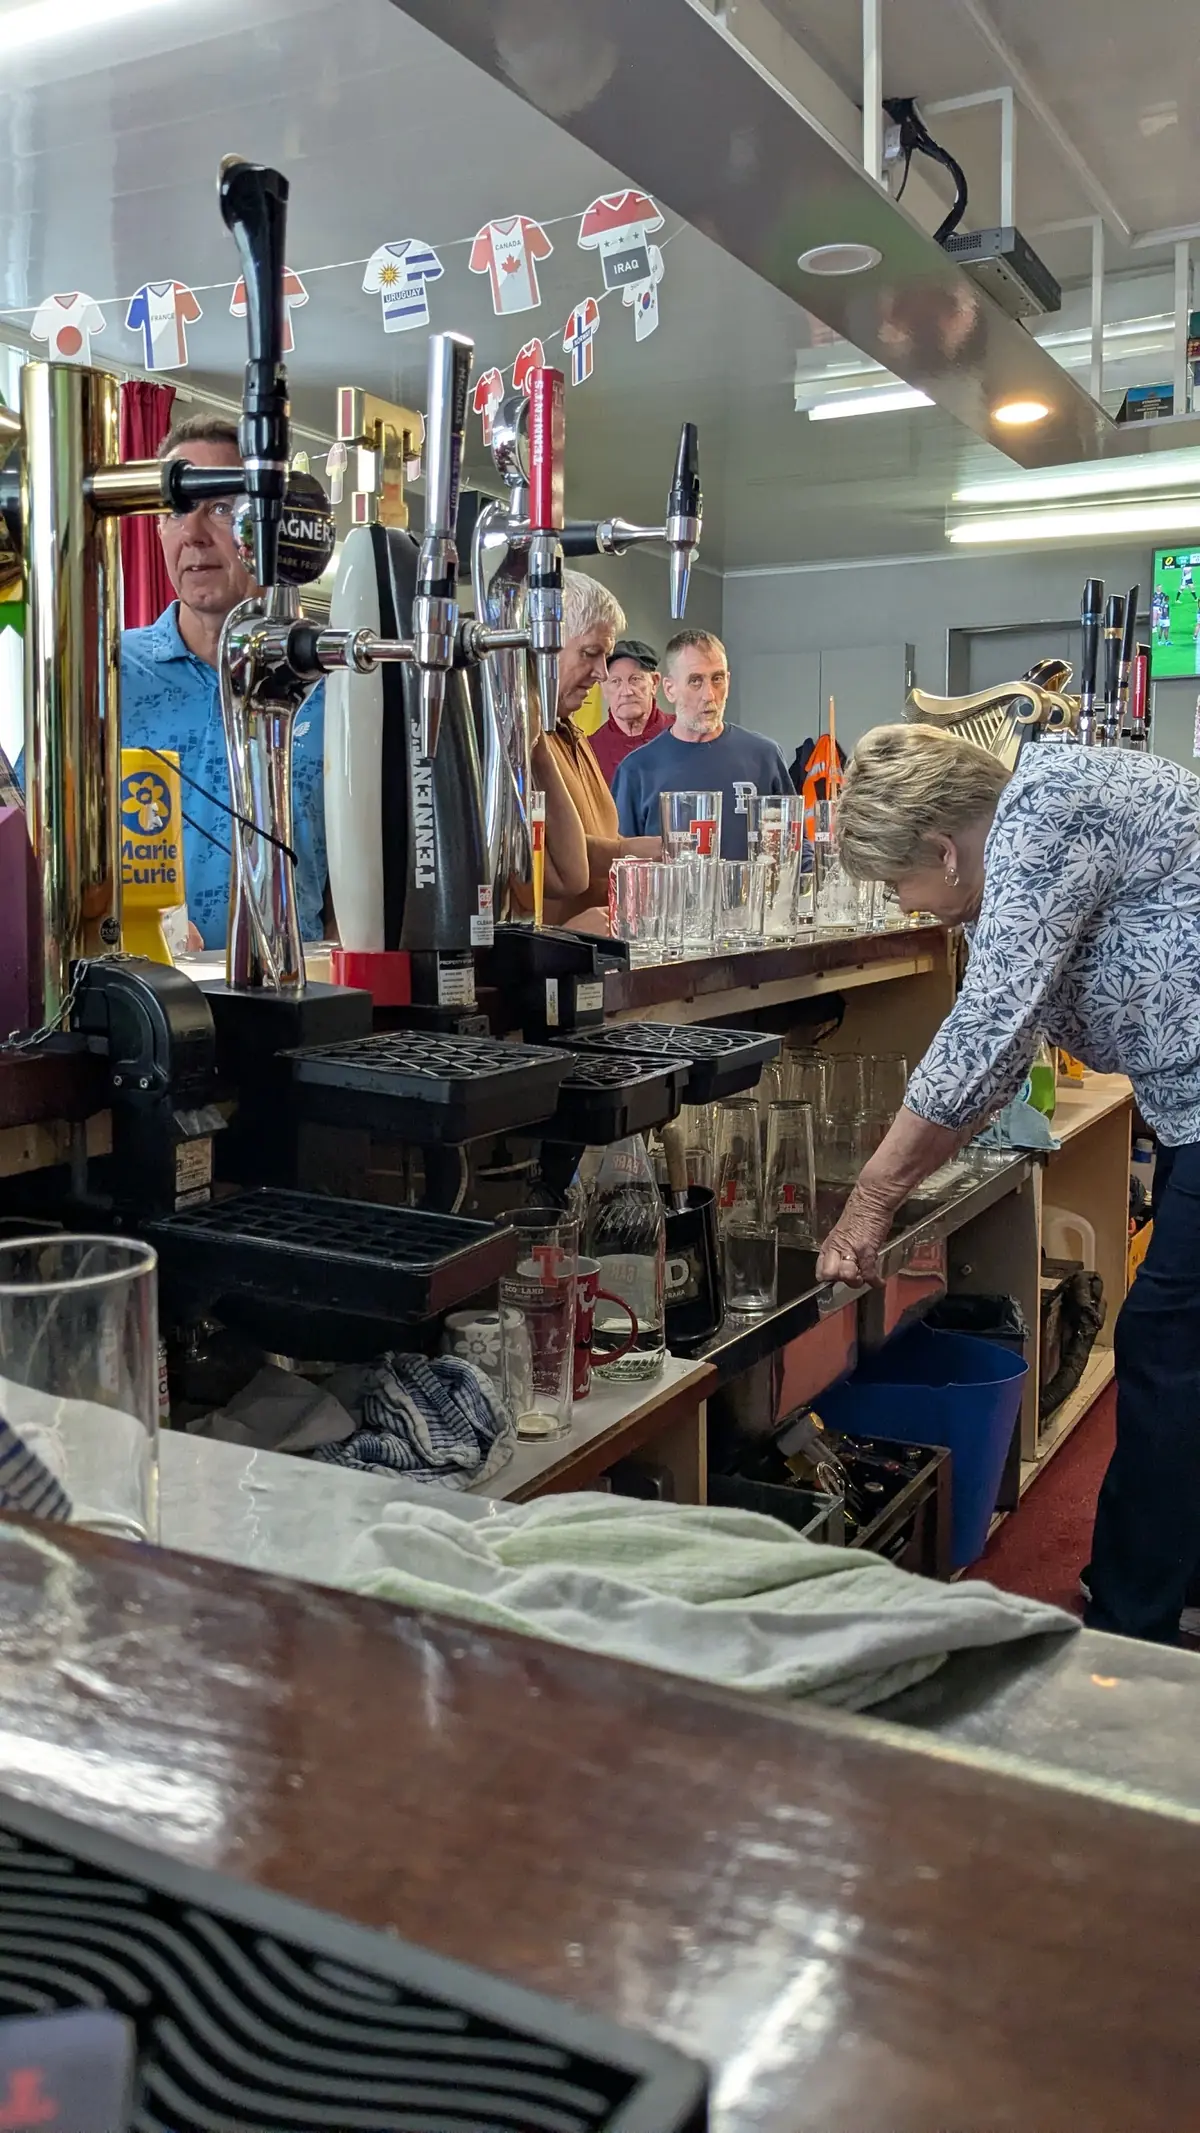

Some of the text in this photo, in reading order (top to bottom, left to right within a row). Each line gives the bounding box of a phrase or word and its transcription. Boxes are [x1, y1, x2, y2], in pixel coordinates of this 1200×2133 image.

[495, 239, 522, 251] CANADA
[613, 258, 640, 275] IRAQ
[385, 288, 422, 303] URUGUAY
[150, 313, 175, 322] FRANCE
[533, 379, 544, 466] TENNENT'S
[278, 518, 334, 543] AGNER
[690, 820, 717, 855] T
[121, 864, 177, 884] Curie
[532, 1246, 564, 1288] T
[504, 1284, 545, 1297] SCOLAND
